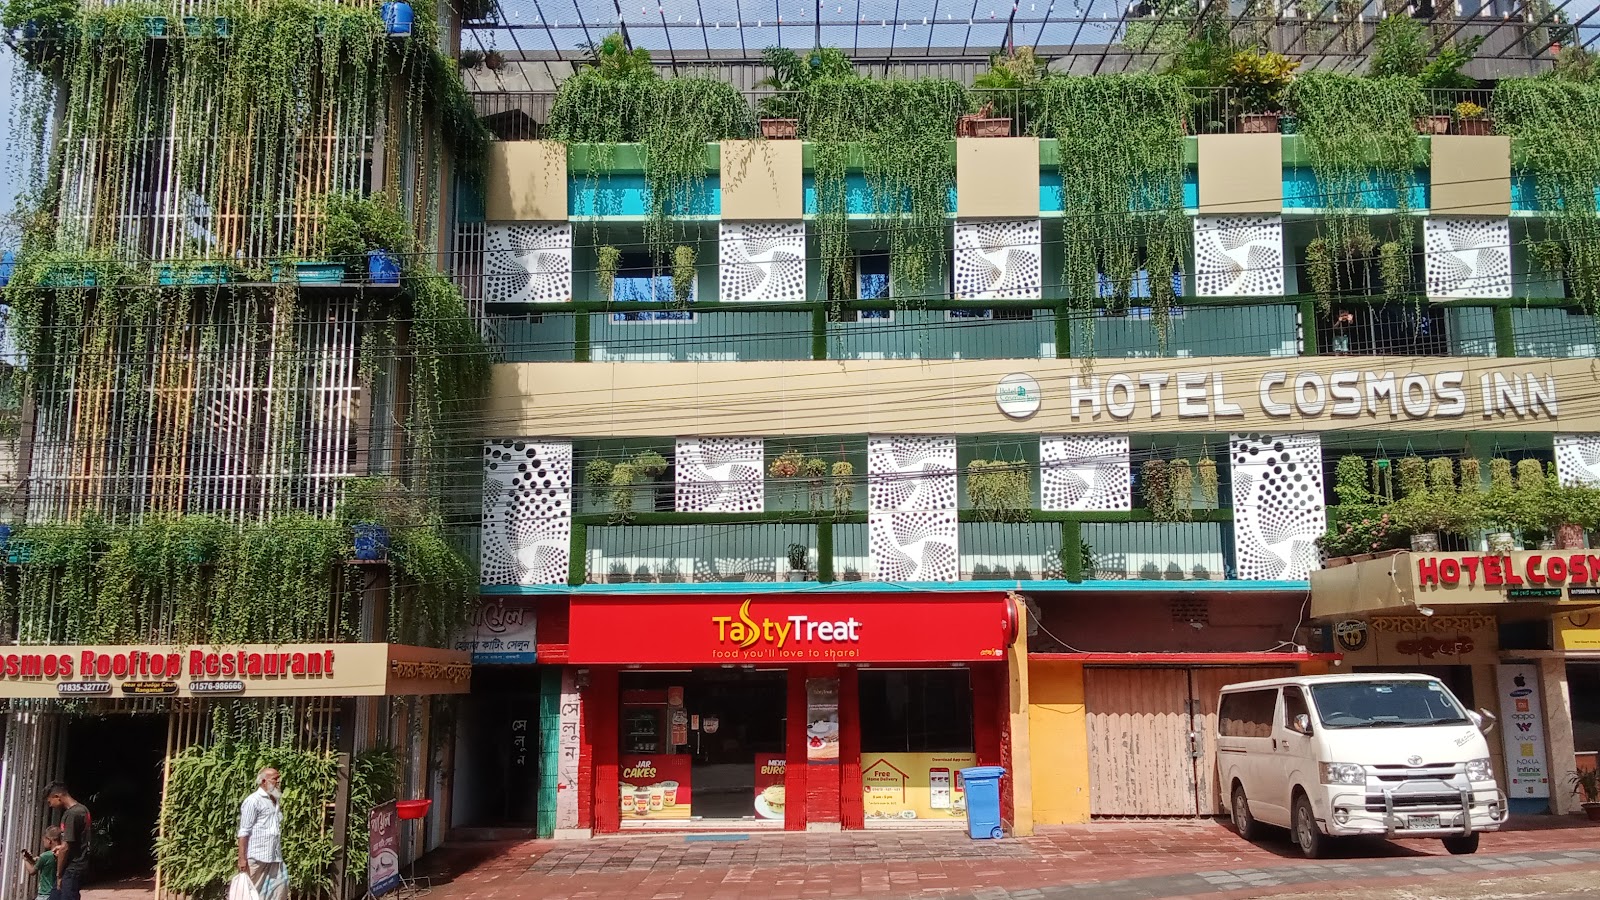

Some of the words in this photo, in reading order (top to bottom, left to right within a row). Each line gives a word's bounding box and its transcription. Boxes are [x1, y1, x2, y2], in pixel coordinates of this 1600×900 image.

[1069, 371, 1245, 422] HOTEL
[1259, 370, 1466, 420] COSMOS
[1479, 371, 1558, 421] INN
[1418, 556, 1524, 586] HOTEL
[506, 640, 530, 651] সেলুন
[712, 649, 739, 658] food
[743, 649, 775, 659] you'll
[779, 649, 804, 658] love
[808, 649, 820, 658] to
[824, 649, 860, 658] share!
[80, 650, 182, 677] Rooftop
[189, 649, 335, 676] Restaurant
[636, 760, 652, 768] JAR
[623, 768, 657, 778] CAKES
